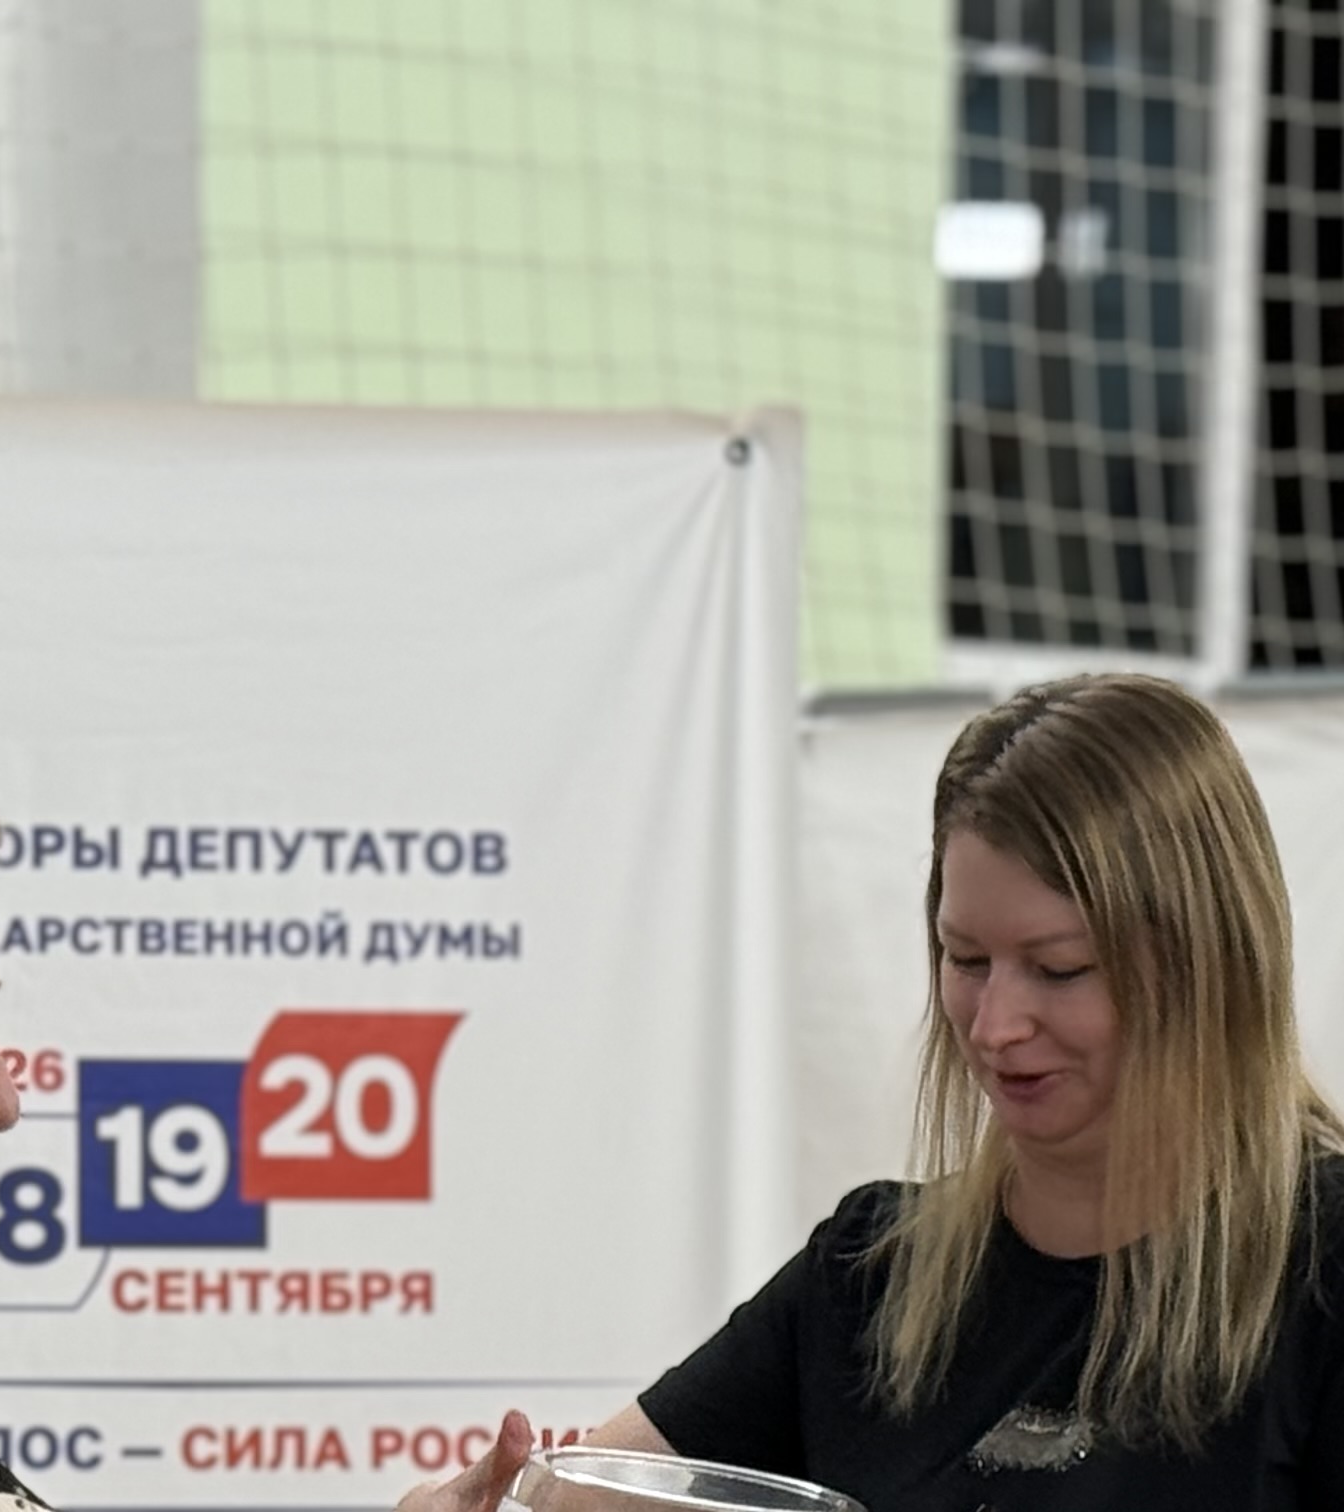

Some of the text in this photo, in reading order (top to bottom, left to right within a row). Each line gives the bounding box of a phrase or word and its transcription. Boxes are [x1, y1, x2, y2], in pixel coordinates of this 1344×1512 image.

[138, 827, 508, 878] ДЕПУТАТОВ
[363, 920, 522, 964] ДУМЫ
[0, 1048, 65, 1092] 26
[96, 1104, 230, 1212] 19
[258, 1053, 420, 1160] 20
[111, 1268, 434, 1315] СЕНТЯБРЯ
[180, 1426, 351, 1471] СИЛА
